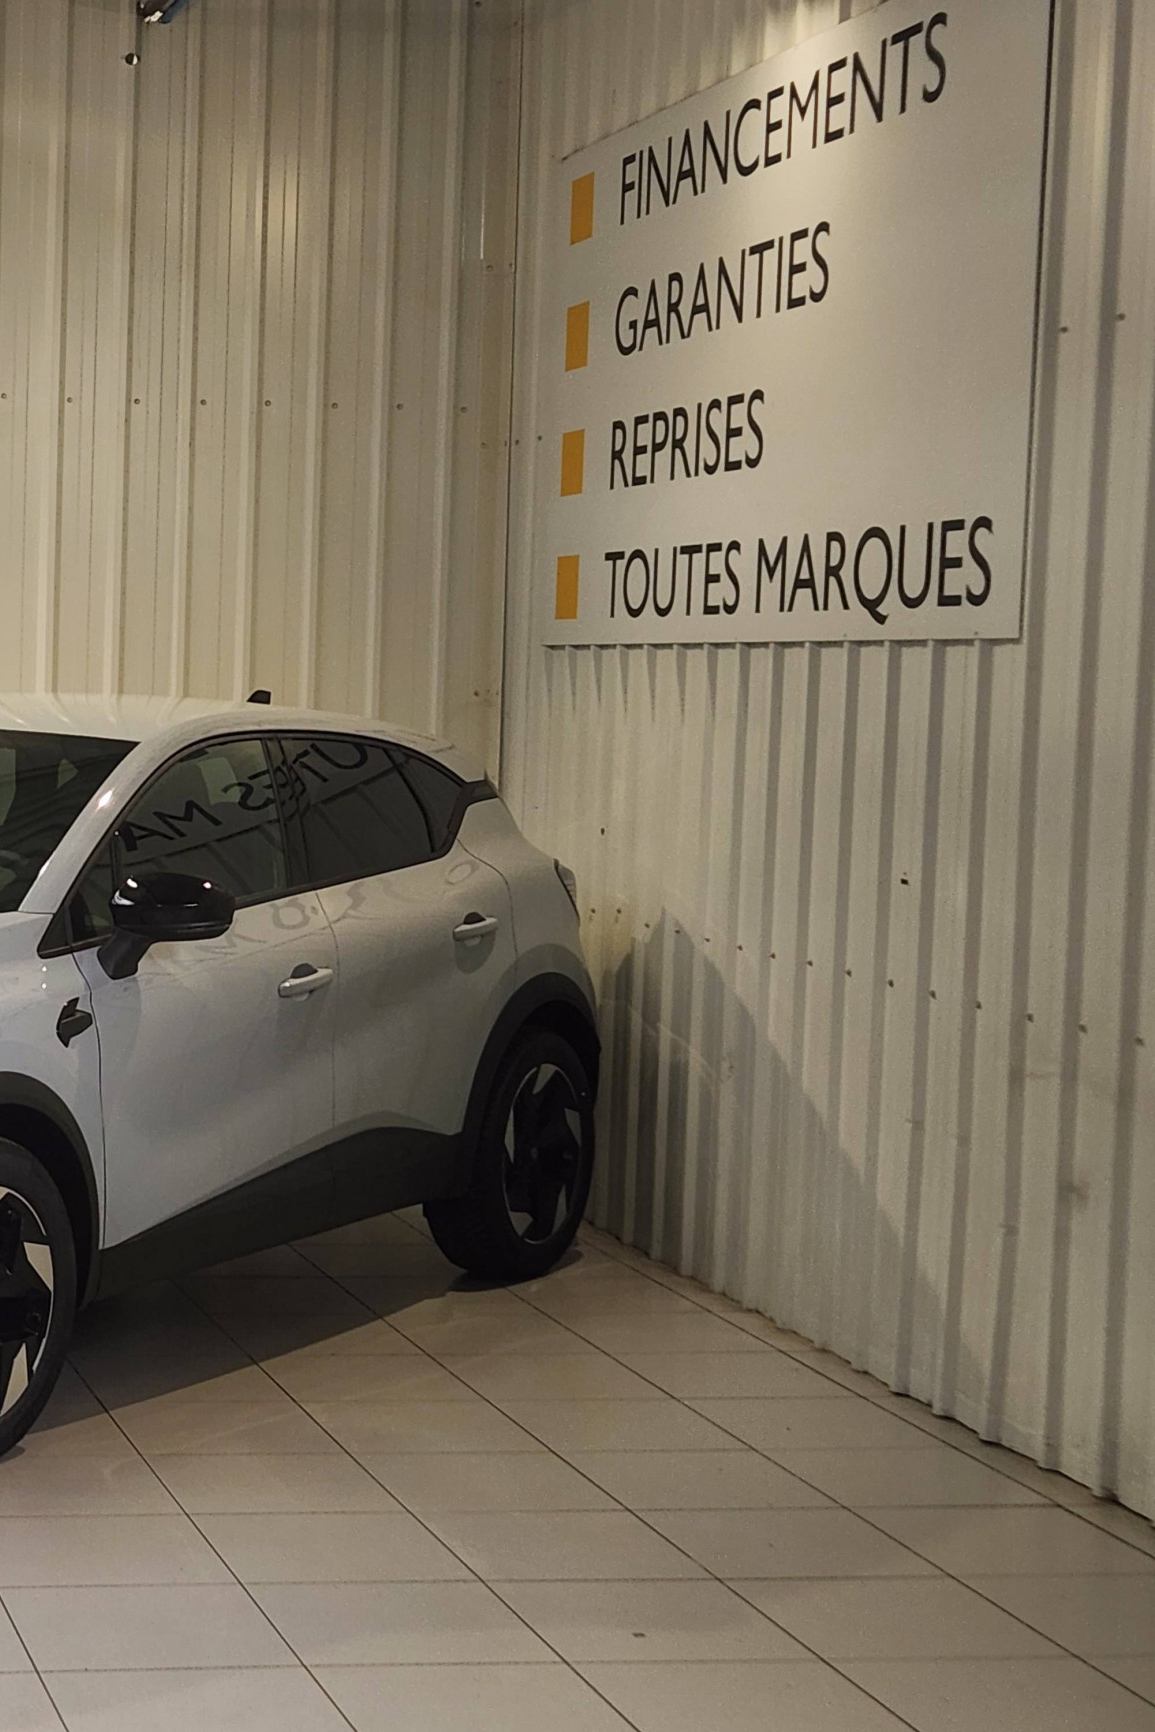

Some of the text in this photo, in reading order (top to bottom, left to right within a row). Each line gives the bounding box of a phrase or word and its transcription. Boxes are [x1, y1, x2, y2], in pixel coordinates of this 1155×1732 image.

[619, 12, 948, 226] FINANCEMENTS
[614, 221, 831, 357] GARANTIES
[609, 389, 765, 491] REPRISES
[604, 516, 994, 625] TOUTES MARQUES
